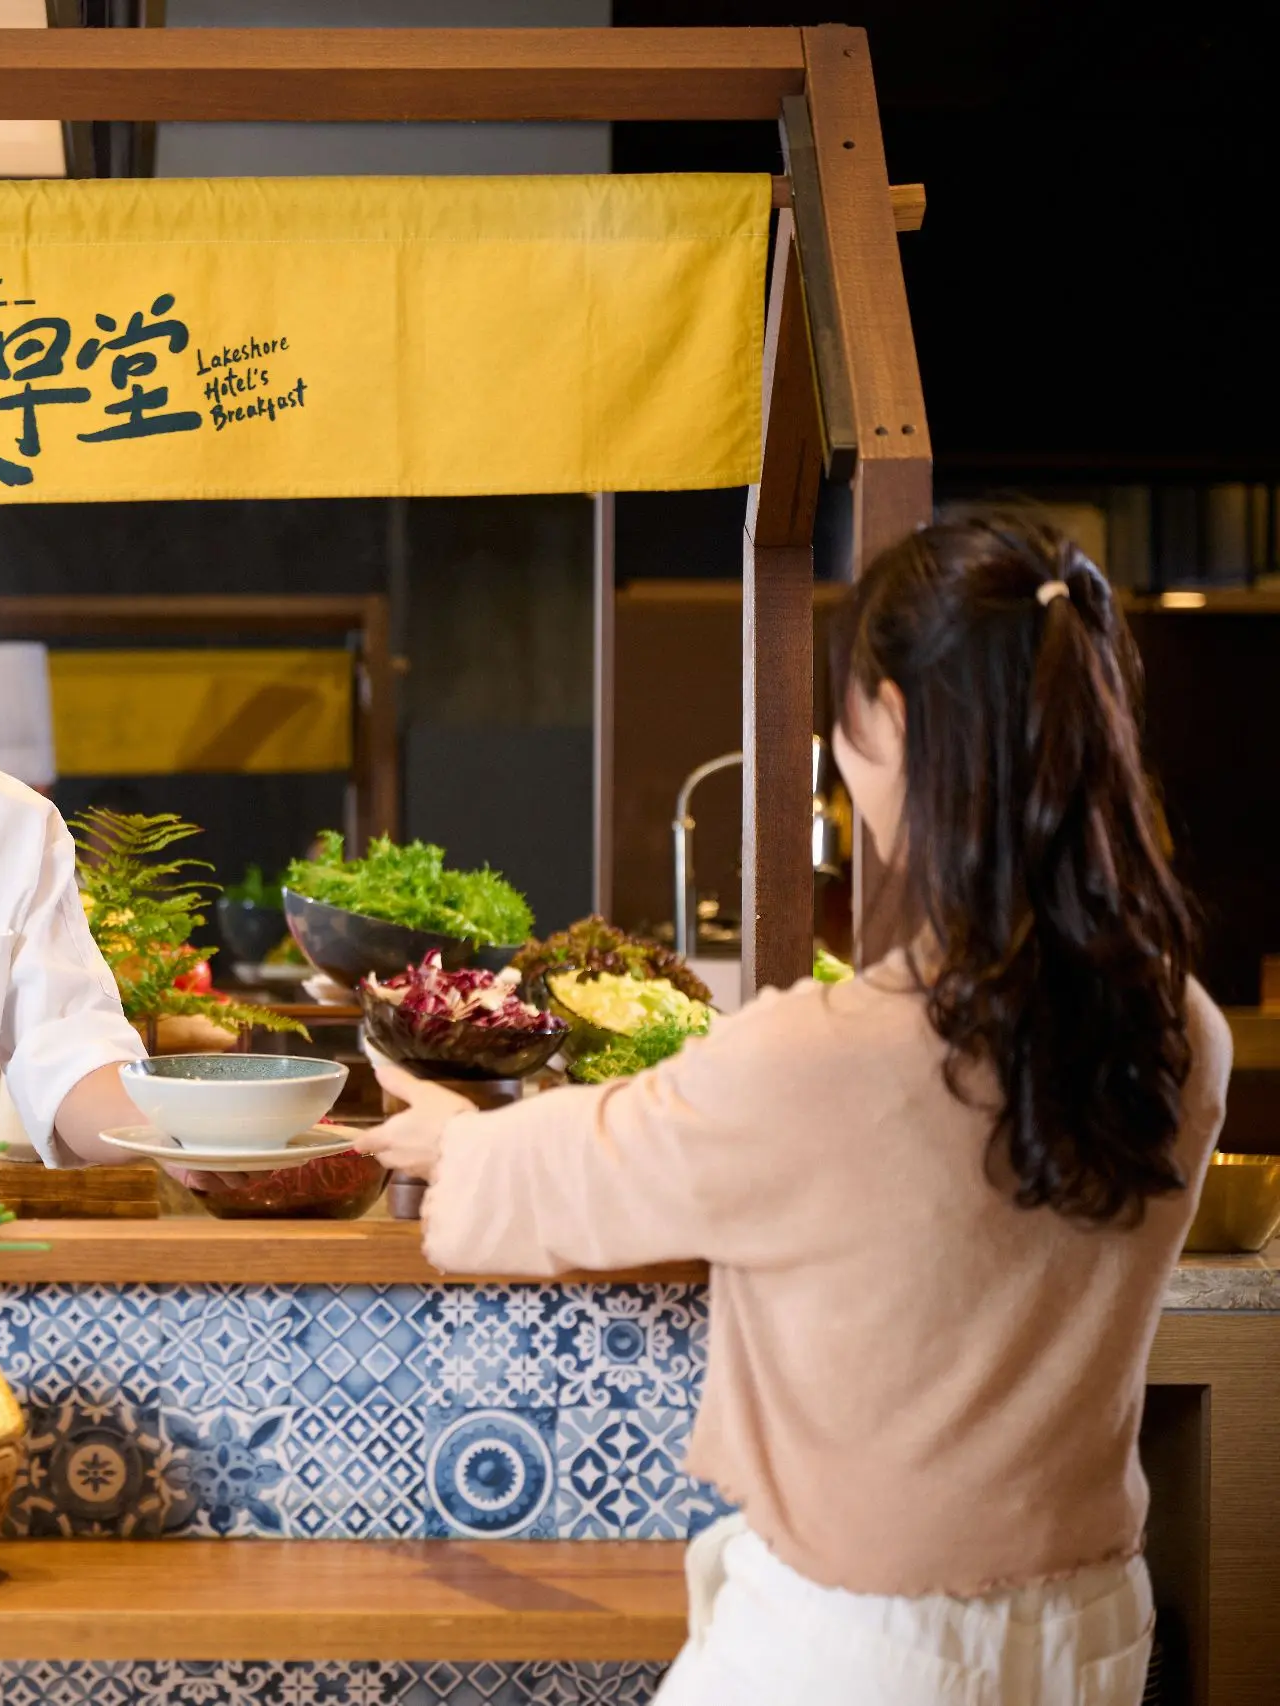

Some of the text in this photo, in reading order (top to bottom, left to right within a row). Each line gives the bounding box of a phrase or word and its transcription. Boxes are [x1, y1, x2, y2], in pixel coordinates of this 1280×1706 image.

[196, 336, 290, 376] Lakeshore
[204, 367, 269, 404] Hotel's
[209, 377, 308, 432] Breakfast
